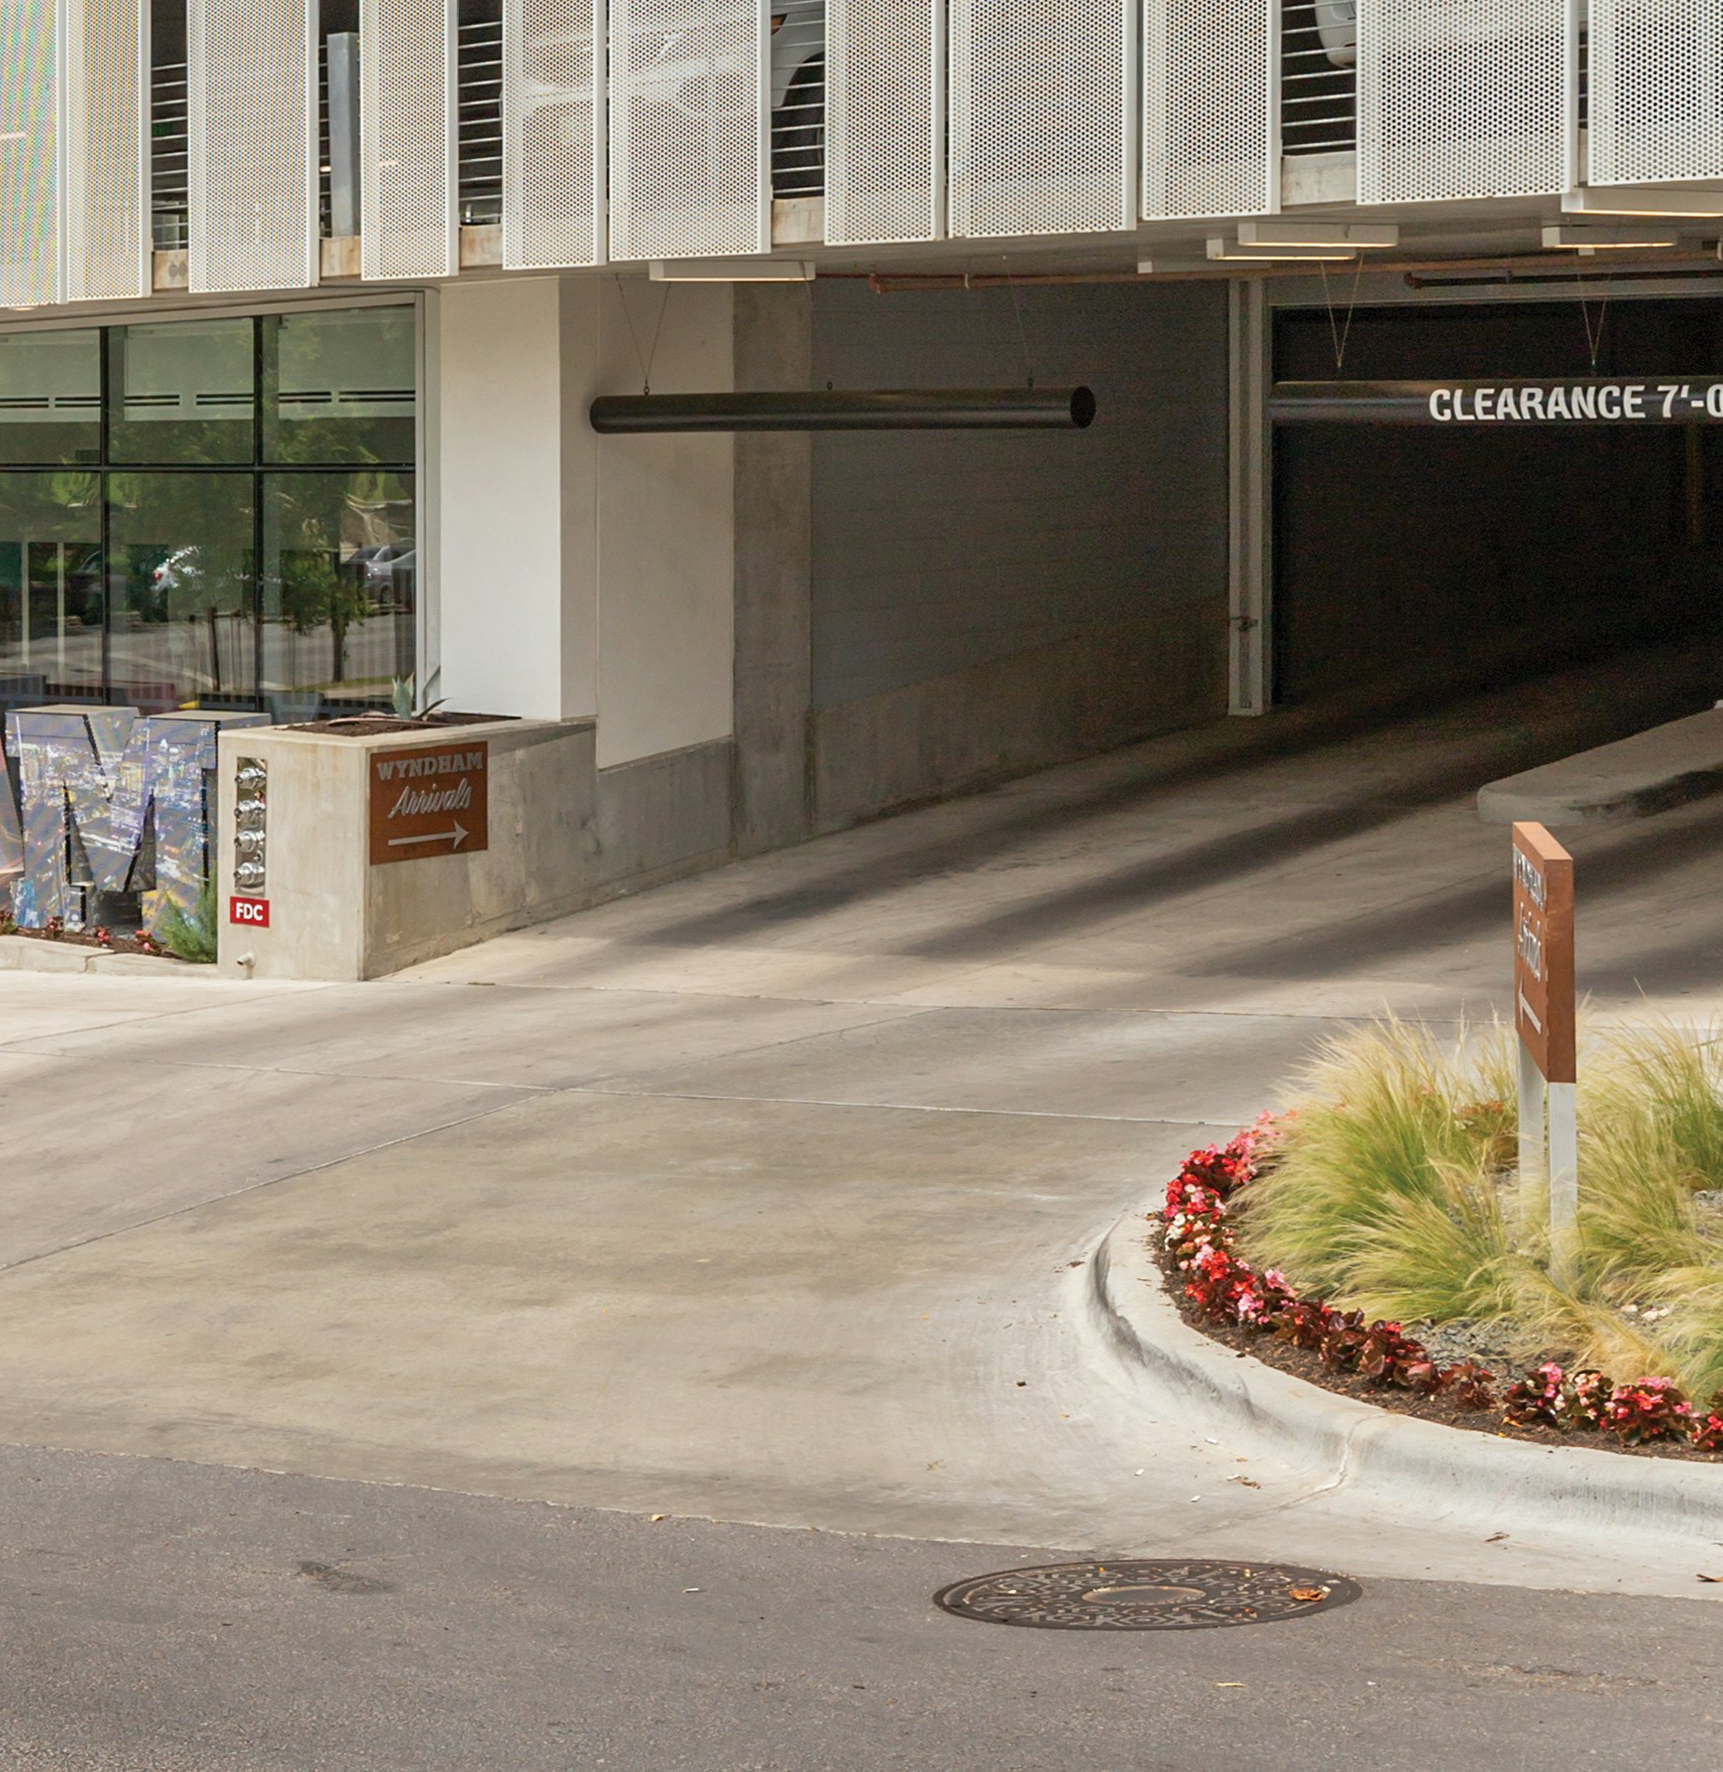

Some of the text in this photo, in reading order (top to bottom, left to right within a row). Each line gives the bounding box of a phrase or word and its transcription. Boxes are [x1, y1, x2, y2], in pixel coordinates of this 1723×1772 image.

[1428, 385, 1647, 422] CLEARANCE
[377, 751, 484, 781] WYNDHAM
[387, 777, 474, 819] Arrivals
[235, 902, 264, 921] FDC
